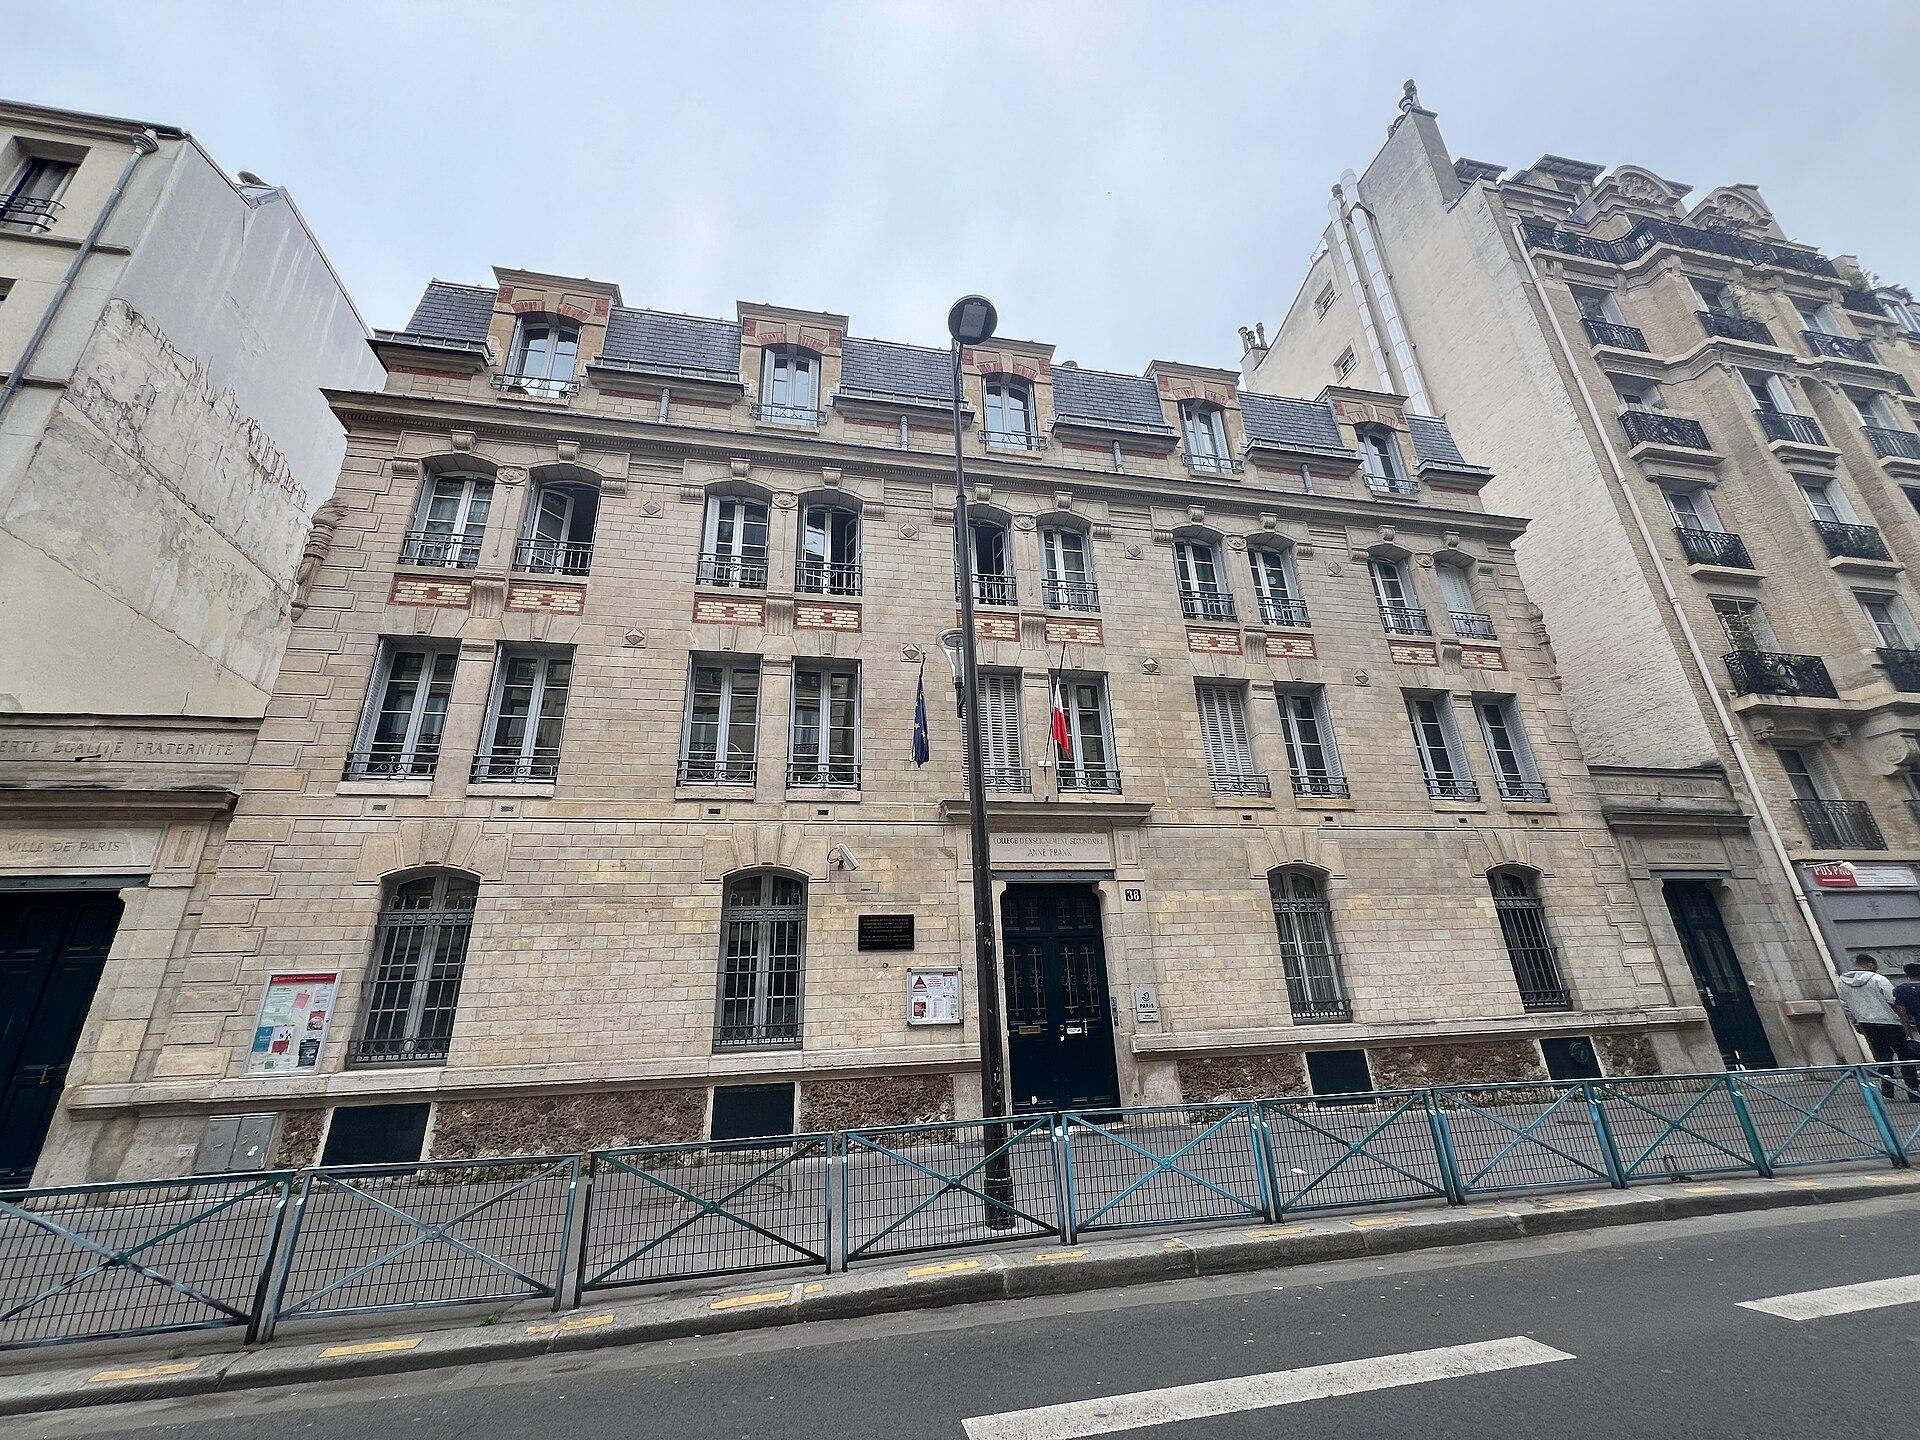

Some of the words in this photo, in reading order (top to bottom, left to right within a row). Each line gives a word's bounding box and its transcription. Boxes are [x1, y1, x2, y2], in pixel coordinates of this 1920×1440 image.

[7, 841, 44, 853] VILLE
[52, 841, 73, 852] DE
[79, 841, 121, 852] PARIS
[1028, 849, 1046, 857] ANNE
[1050, 849, 1073, 857] FRANK
[1126, 890, 1140, 900] 38
